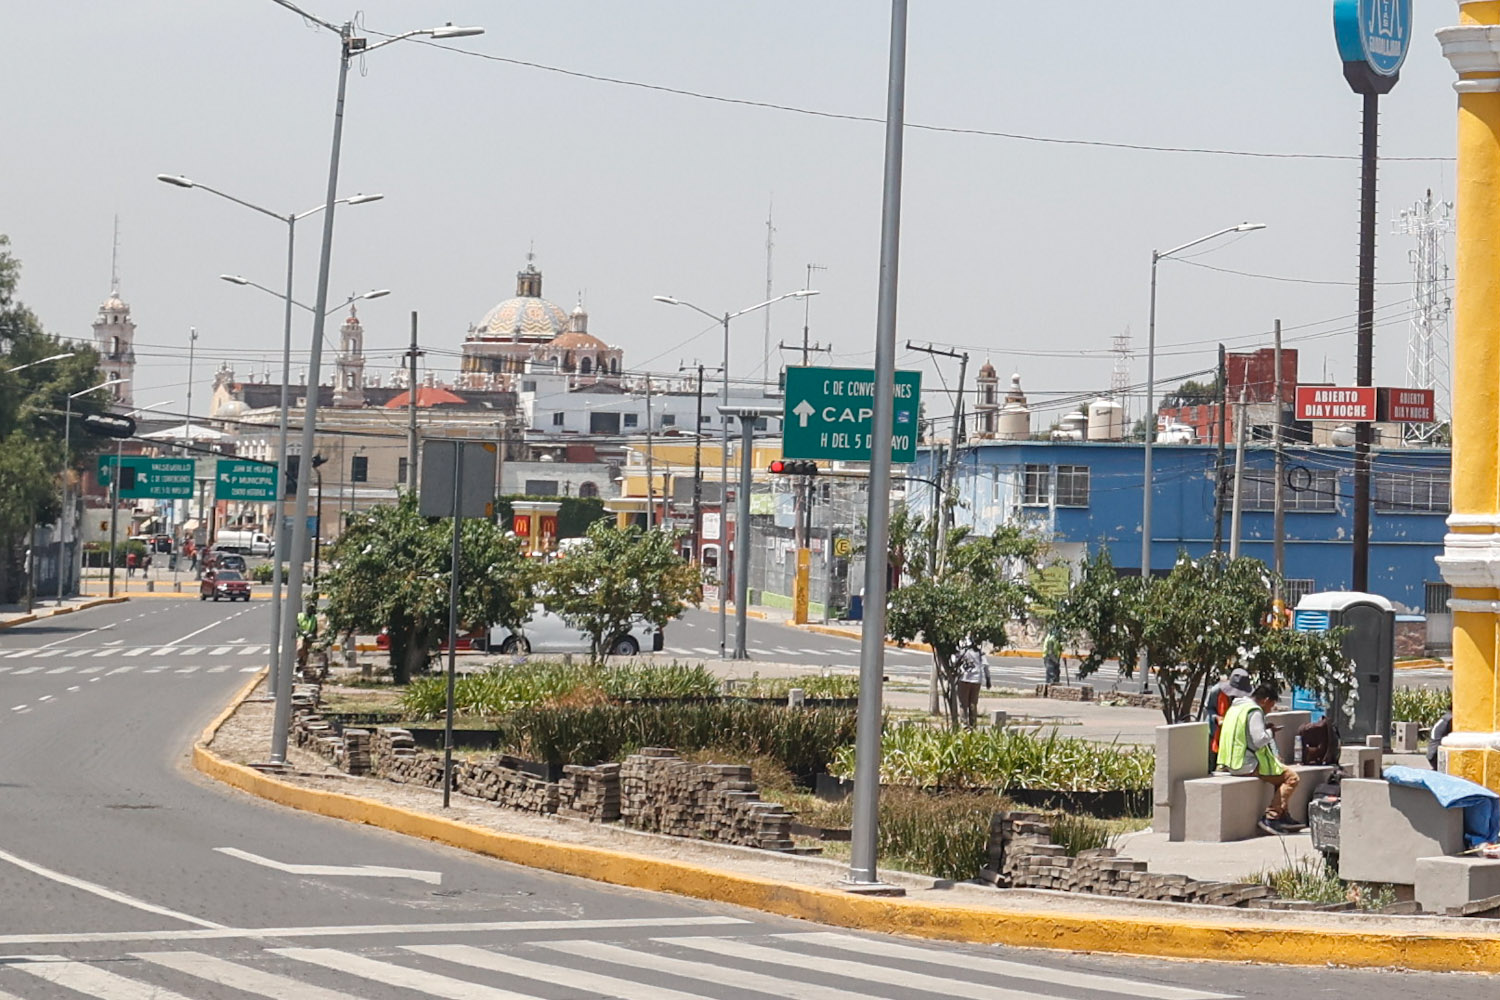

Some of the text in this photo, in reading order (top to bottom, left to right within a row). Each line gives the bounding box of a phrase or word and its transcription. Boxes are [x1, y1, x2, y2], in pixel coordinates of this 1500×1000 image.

[823, 380, 912, 398] C DE CONVENES
[1315, 391, 1358, 403] ABIERTO
[1400, 392, 1425, 405] ABIERTO
[822, 407, 873, 422] CAP
[1305, 405, 1367, 417] DIA Y NOCHE
[1410, 407, 1429, 419] NOCHE
[820, 433, 828, 448] H
[832, 434, 850, 449] DEL
[855, 434, 861, 448] 5
[889, 435, 909, 450] AYO
